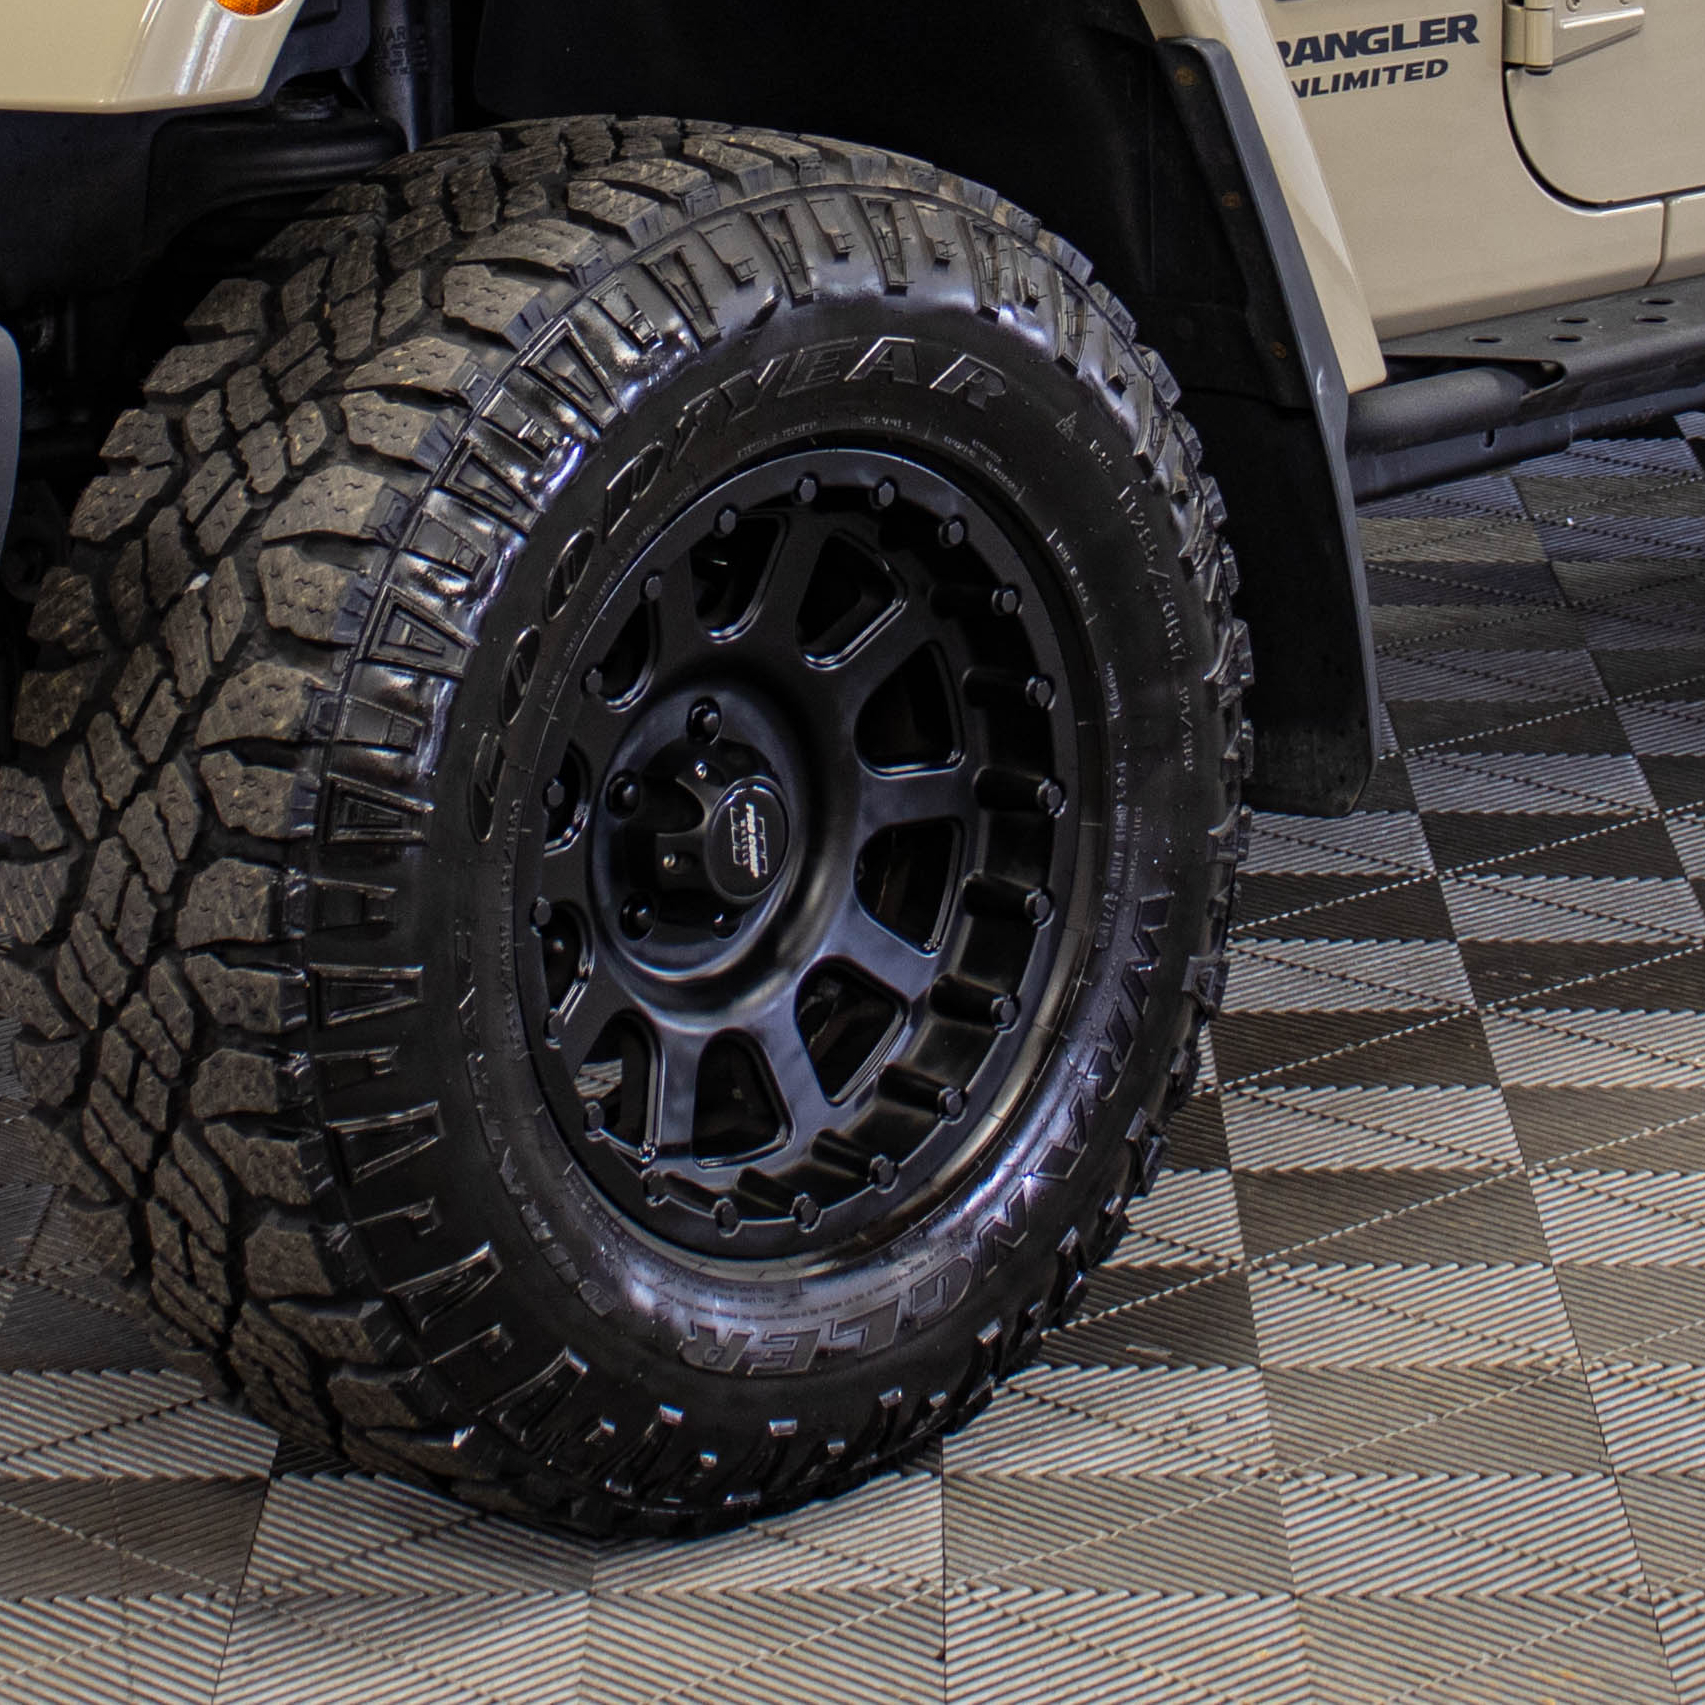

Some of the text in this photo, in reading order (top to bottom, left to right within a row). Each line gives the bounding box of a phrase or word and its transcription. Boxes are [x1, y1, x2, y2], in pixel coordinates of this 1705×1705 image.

[1276, 13, 1480, 68] RANGLER
[1291, 58, 1450, 98] NLIMITED
[467, 335, 1008, 844] GOODYEAR
[679, 891, 1176, 1378] WRANGLER
